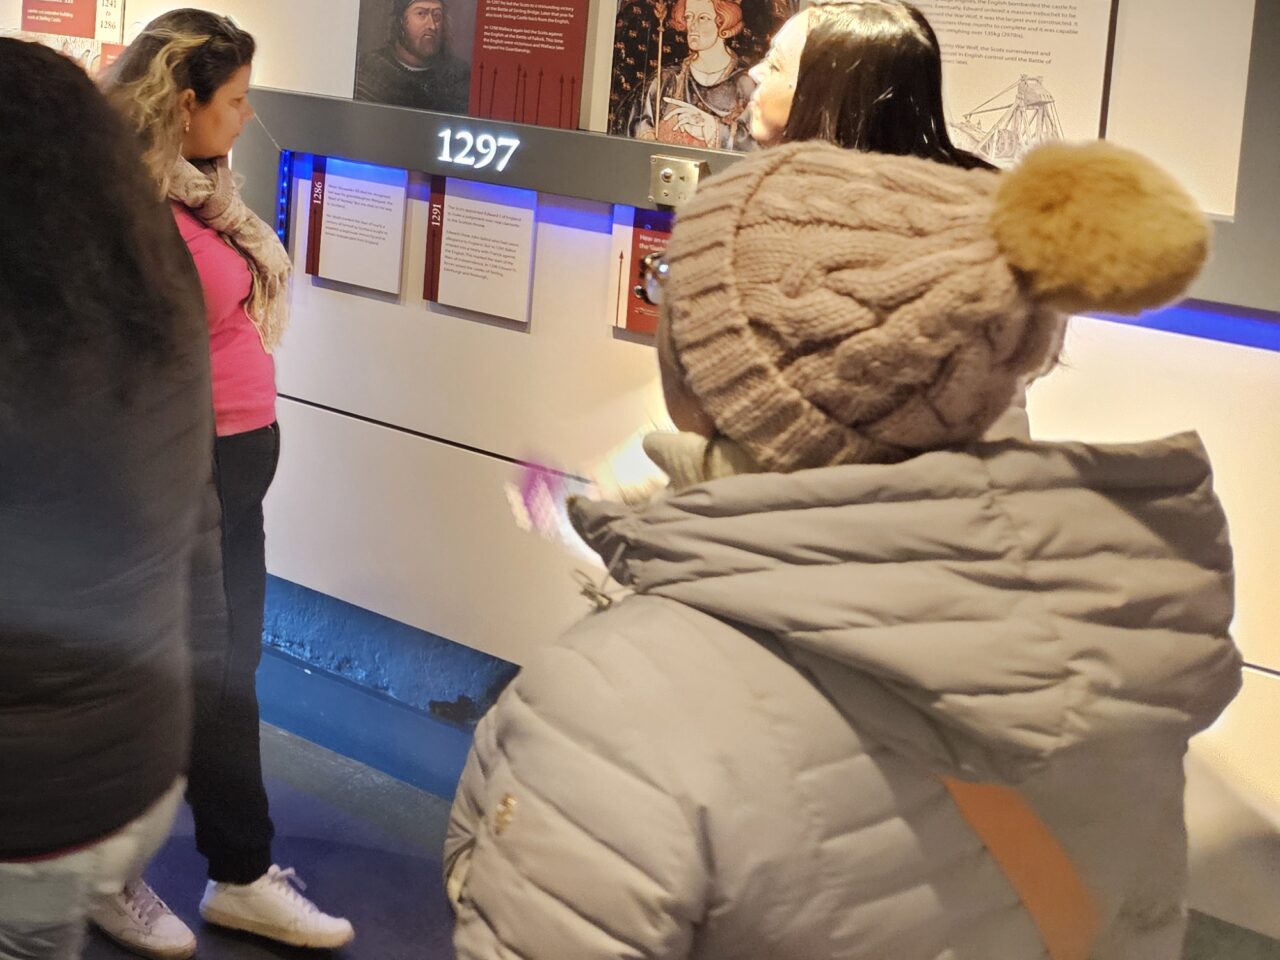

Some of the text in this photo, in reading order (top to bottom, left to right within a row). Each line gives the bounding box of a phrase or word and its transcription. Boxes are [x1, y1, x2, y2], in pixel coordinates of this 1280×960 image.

[102, 0, 117, 8] 1241
[437, 128, 520, 172] 1297
[313, 181, 323, 205] 1286
[431, 204, 442, 226] 1291
